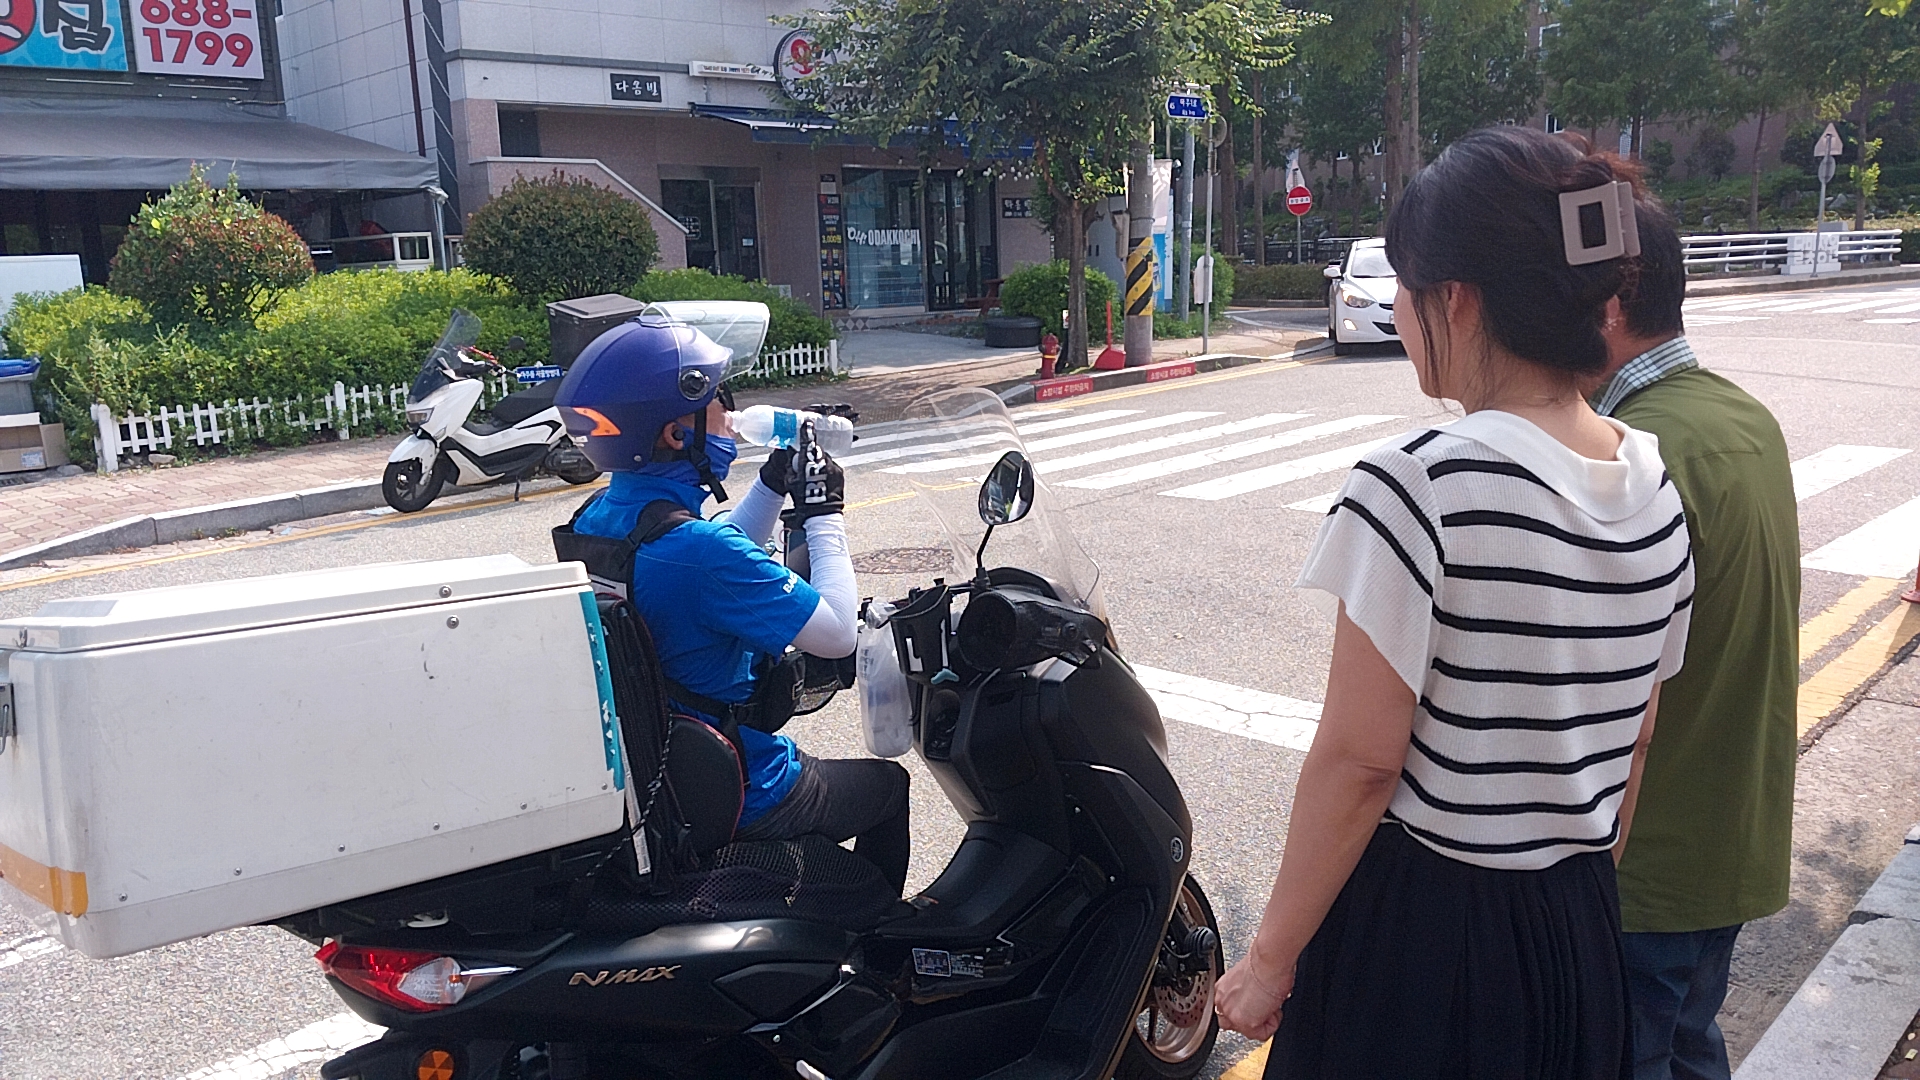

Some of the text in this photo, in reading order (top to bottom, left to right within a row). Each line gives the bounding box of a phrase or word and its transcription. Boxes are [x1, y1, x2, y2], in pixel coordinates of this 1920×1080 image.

[143, 27, 254, 68] 1799
[868, 229, 920, 246] ODAKKOCHI
[568, 964, 682, 987] NMAX
